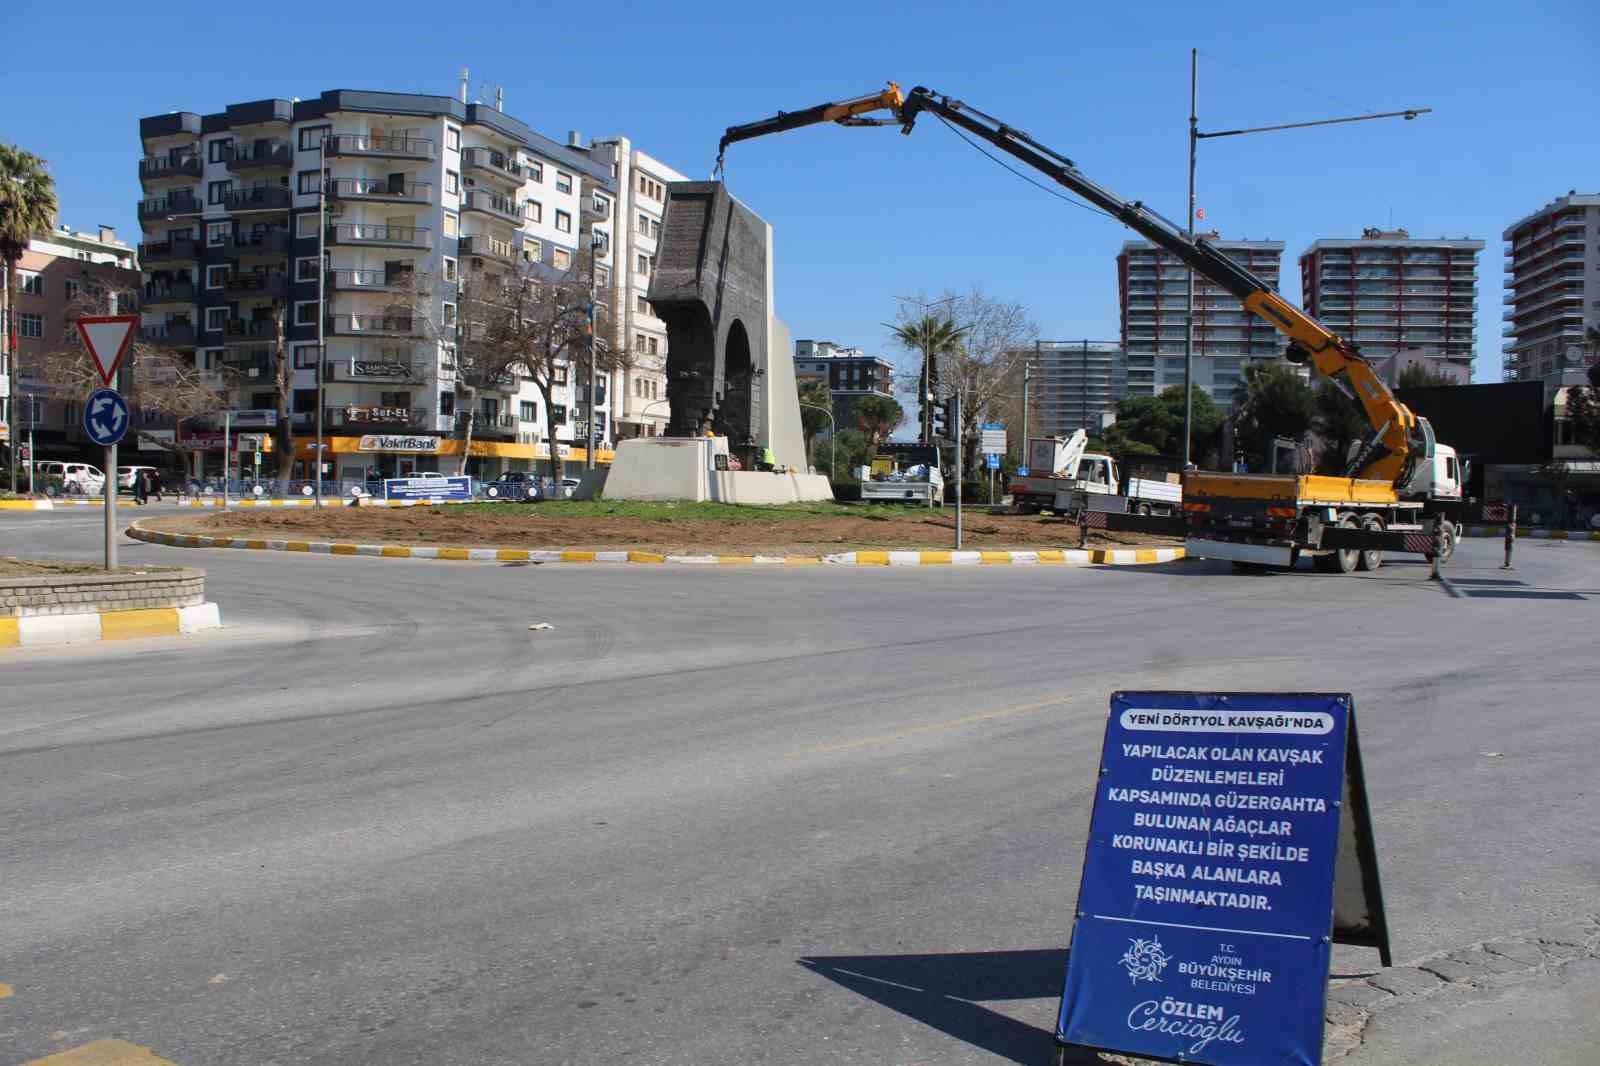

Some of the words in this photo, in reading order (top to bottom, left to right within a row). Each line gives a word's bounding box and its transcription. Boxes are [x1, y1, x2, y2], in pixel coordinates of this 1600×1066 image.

[1129, 713, 1160, 725] YENİ
[1162, 714, 1225, 727] DÖRTYOL
[1228, 716, 1324, 729] KAVŞAĞI'NDA
[1122, 743, 1208, 760] YAPILACAK
[1211, 748, 1253, 762] OLAN
[1257, 749, 1323, 766] KAVŞAK
[1152, 765, 1284, 786] DÜZENLEMELERİ
[1108, 788, 1212, 808] KAPSAMINDA
[1215, 792, 1327, 813] GÜZERGAHTA
[1133, 812, 1211, 831] BULUNAN
[1213, 816, 1292, 837] AĞAÇLAR
[1112, 835, 1203, 855] KORUNAKLI
[1207, 839, 1234, 857] BİR
[1237, 842, 1309, 862] ŞEKİLDE
[1131, 860, 1186, 880] BAŞKA
[1191, 865, 1282, 886] ALANLARA
[1134, 885, 1272, 911] TAŞINMAKTADIR.
[1211, 955, 1242, 966] AYDIN
[1178, 962, 1272, 984] BÜYÜKŞEHİR
[1190, 979, 1256, 995] BELEDİYESİ
[1160, 995, 1224, 1021] ÖZLEM
